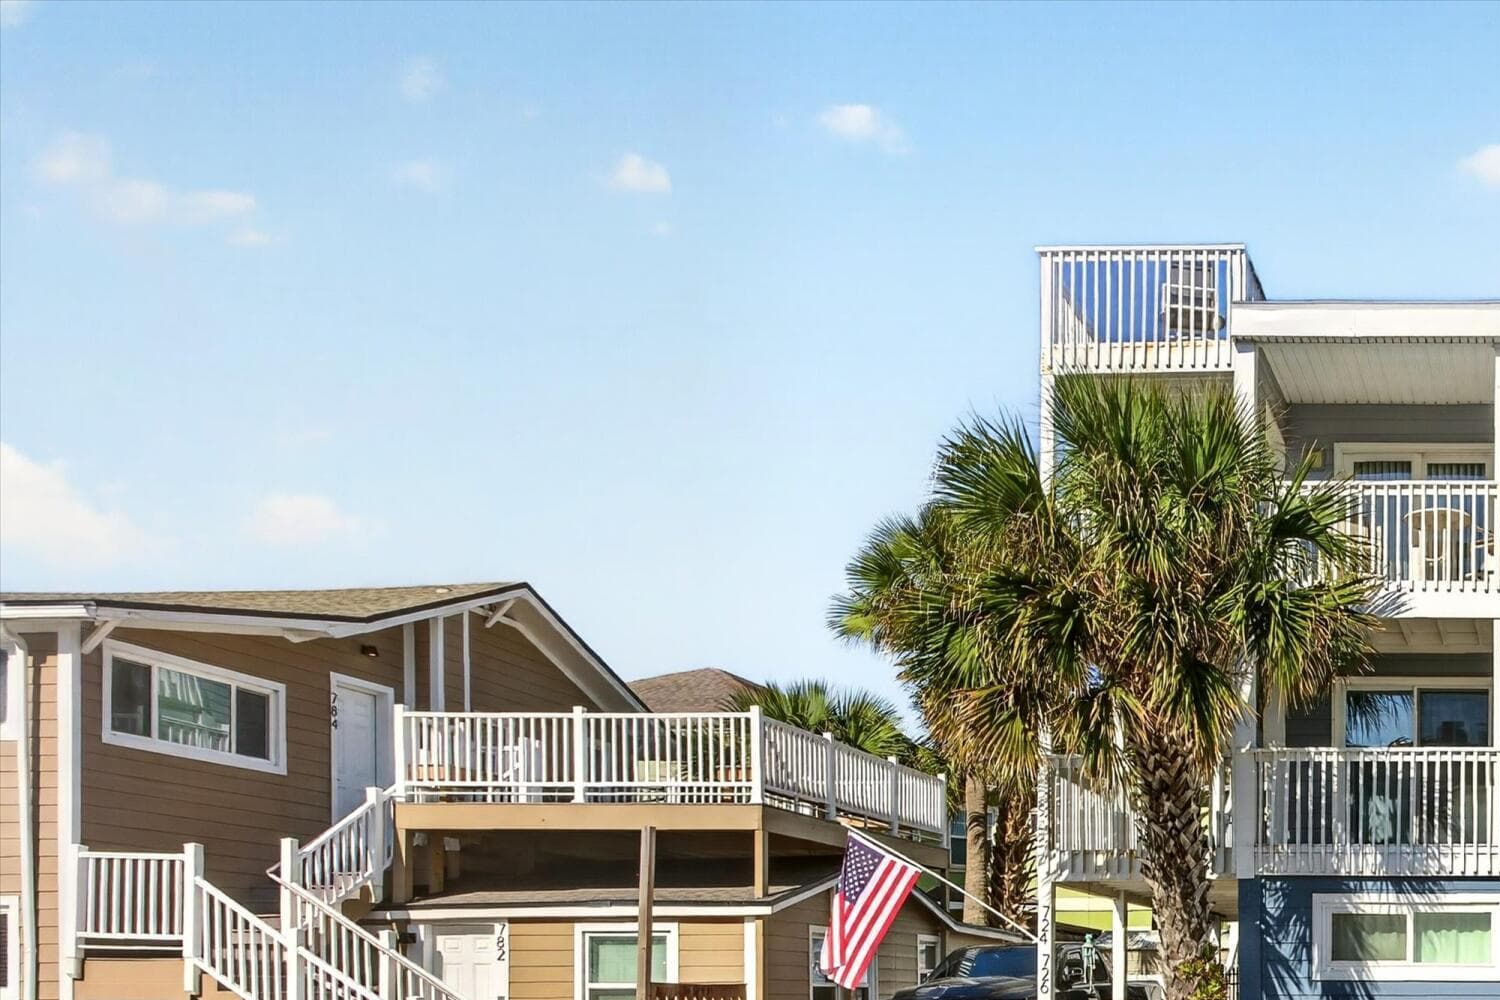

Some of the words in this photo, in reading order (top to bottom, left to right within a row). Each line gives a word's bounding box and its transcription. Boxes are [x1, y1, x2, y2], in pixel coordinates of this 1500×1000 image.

[496, 923, 506, 961] 782
[1039, 906, 1050, 944] 724
[1040, 953, 1050, 994] 726
